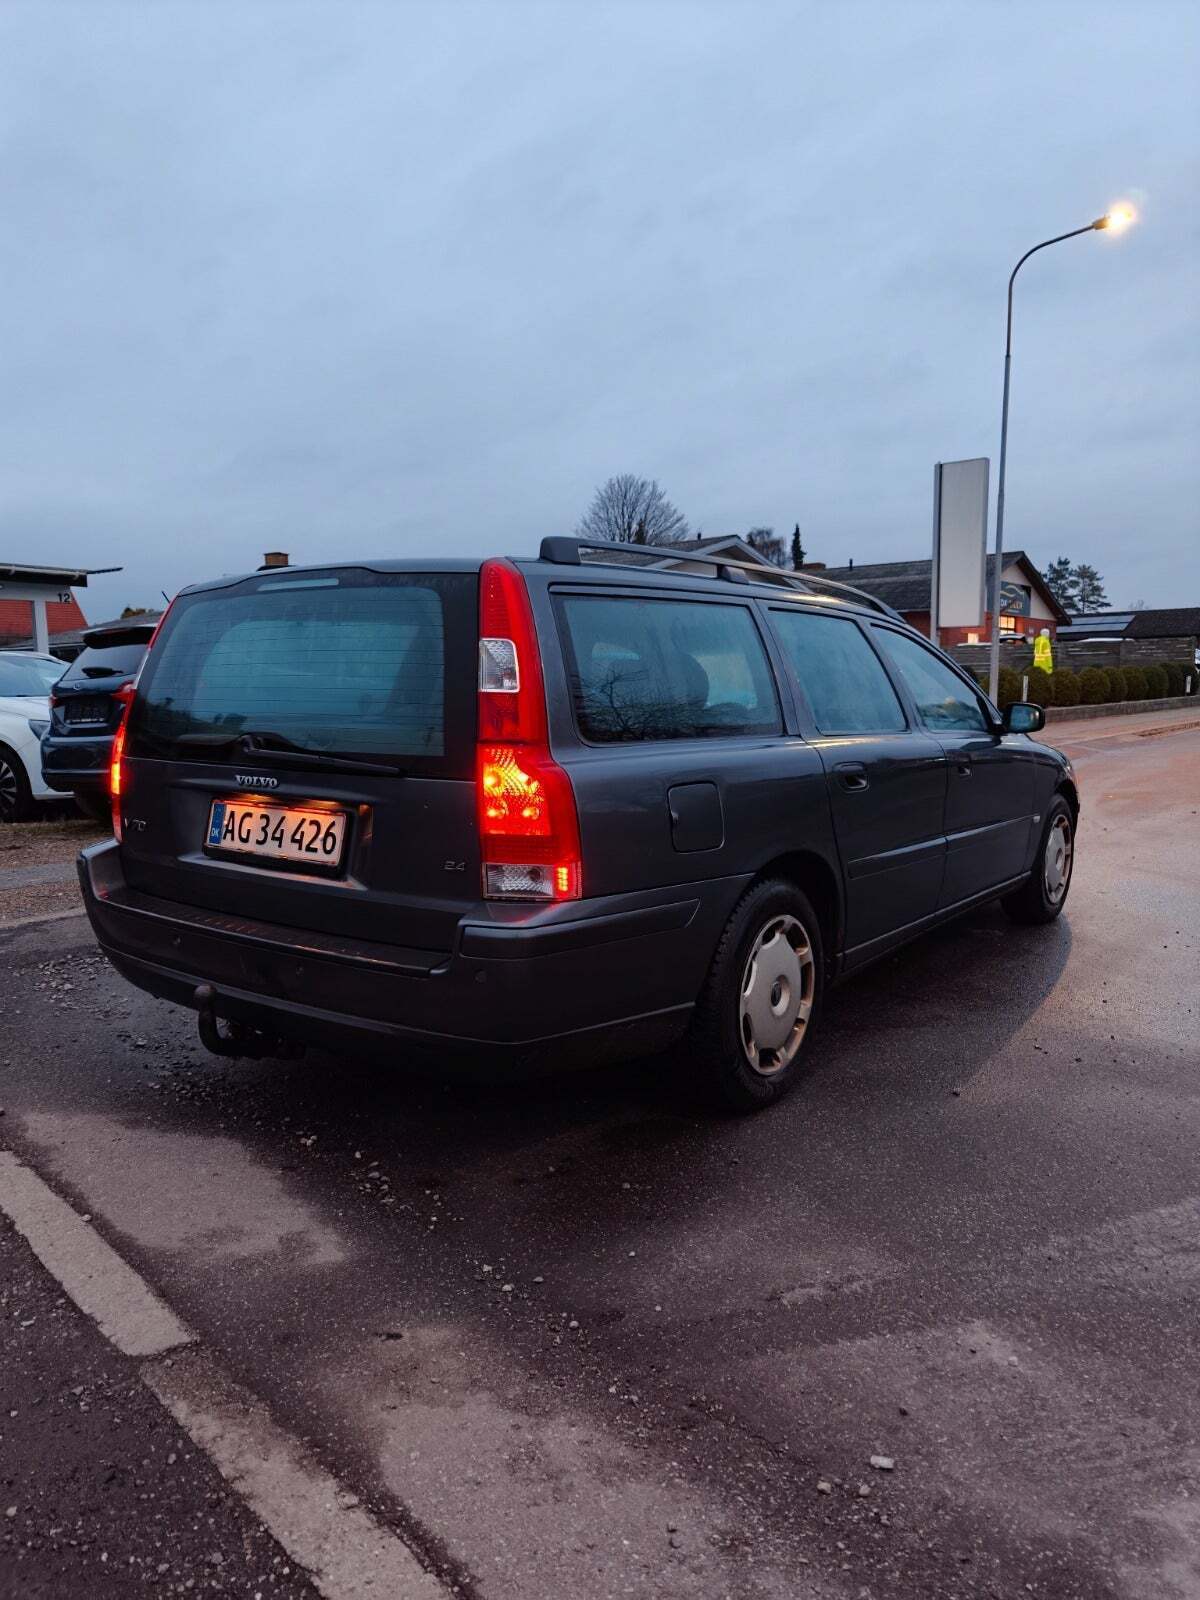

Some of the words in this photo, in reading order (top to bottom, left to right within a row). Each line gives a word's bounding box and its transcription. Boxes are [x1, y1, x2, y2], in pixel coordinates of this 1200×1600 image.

[58, 592, 70, 603] 12
[234, 774, 279, 788] VOLVO
[222, 810, 253, 844] AG
[255, 813, 287, 849] 34
[290, 817, 338, 856] 426
